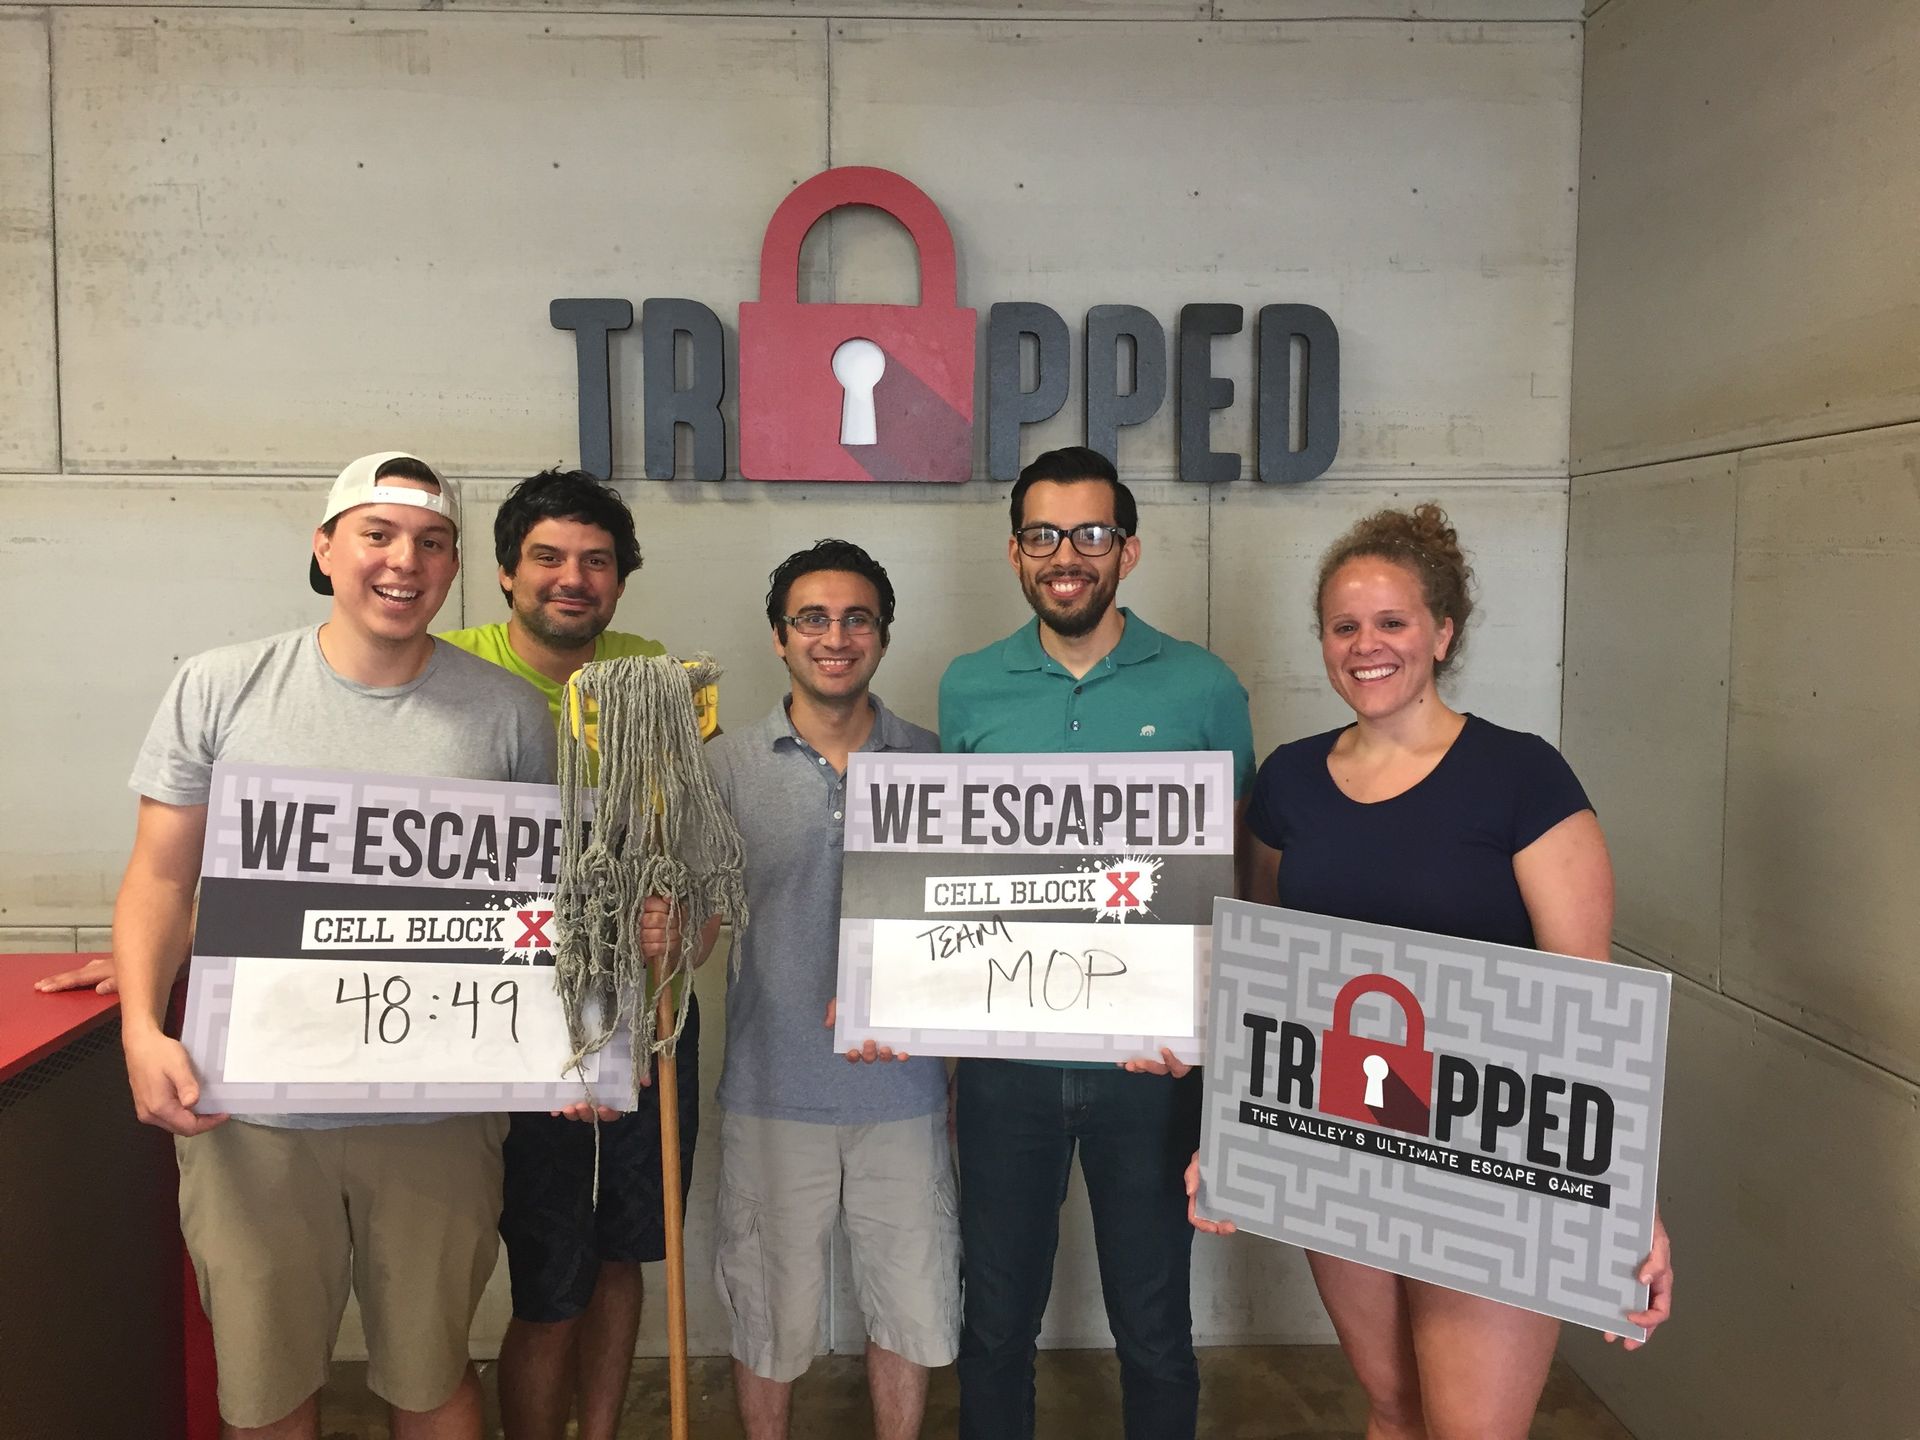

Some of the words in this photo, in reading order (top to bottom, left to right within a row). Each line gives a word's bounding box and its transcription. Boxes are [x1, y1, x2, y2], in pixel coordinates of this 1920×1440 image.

[240, 798, 336, 873] WE
[352, 806, 628, 885] ESCAPE
[870, 783, 946, 845] WE
[961, 783, 1205, 846] ESCAPED!
[934, 881, 1001, 906] CELL
[1010, 878, 1096, 904] BLOCK
[1106, 871, 1140, 907] X
[314, 916, 395, 943] CELL
[406, 916, 505, 943] BLOCK
[514, 910, 554, 948] X
[916, 914, 1013, 961] TEAM
[335, 971, 519, 1045] 48:49
[1251, 1107, 1279, 1127] THE
[1289, 1117, 1366, 1146] VALLEY'S
[1376, 1139, 1460, 1168] ULTIMATE
[1470, 1160, 1537, 1186] ESCAPE
[1548, 1176, 1594, 1199] GAME
